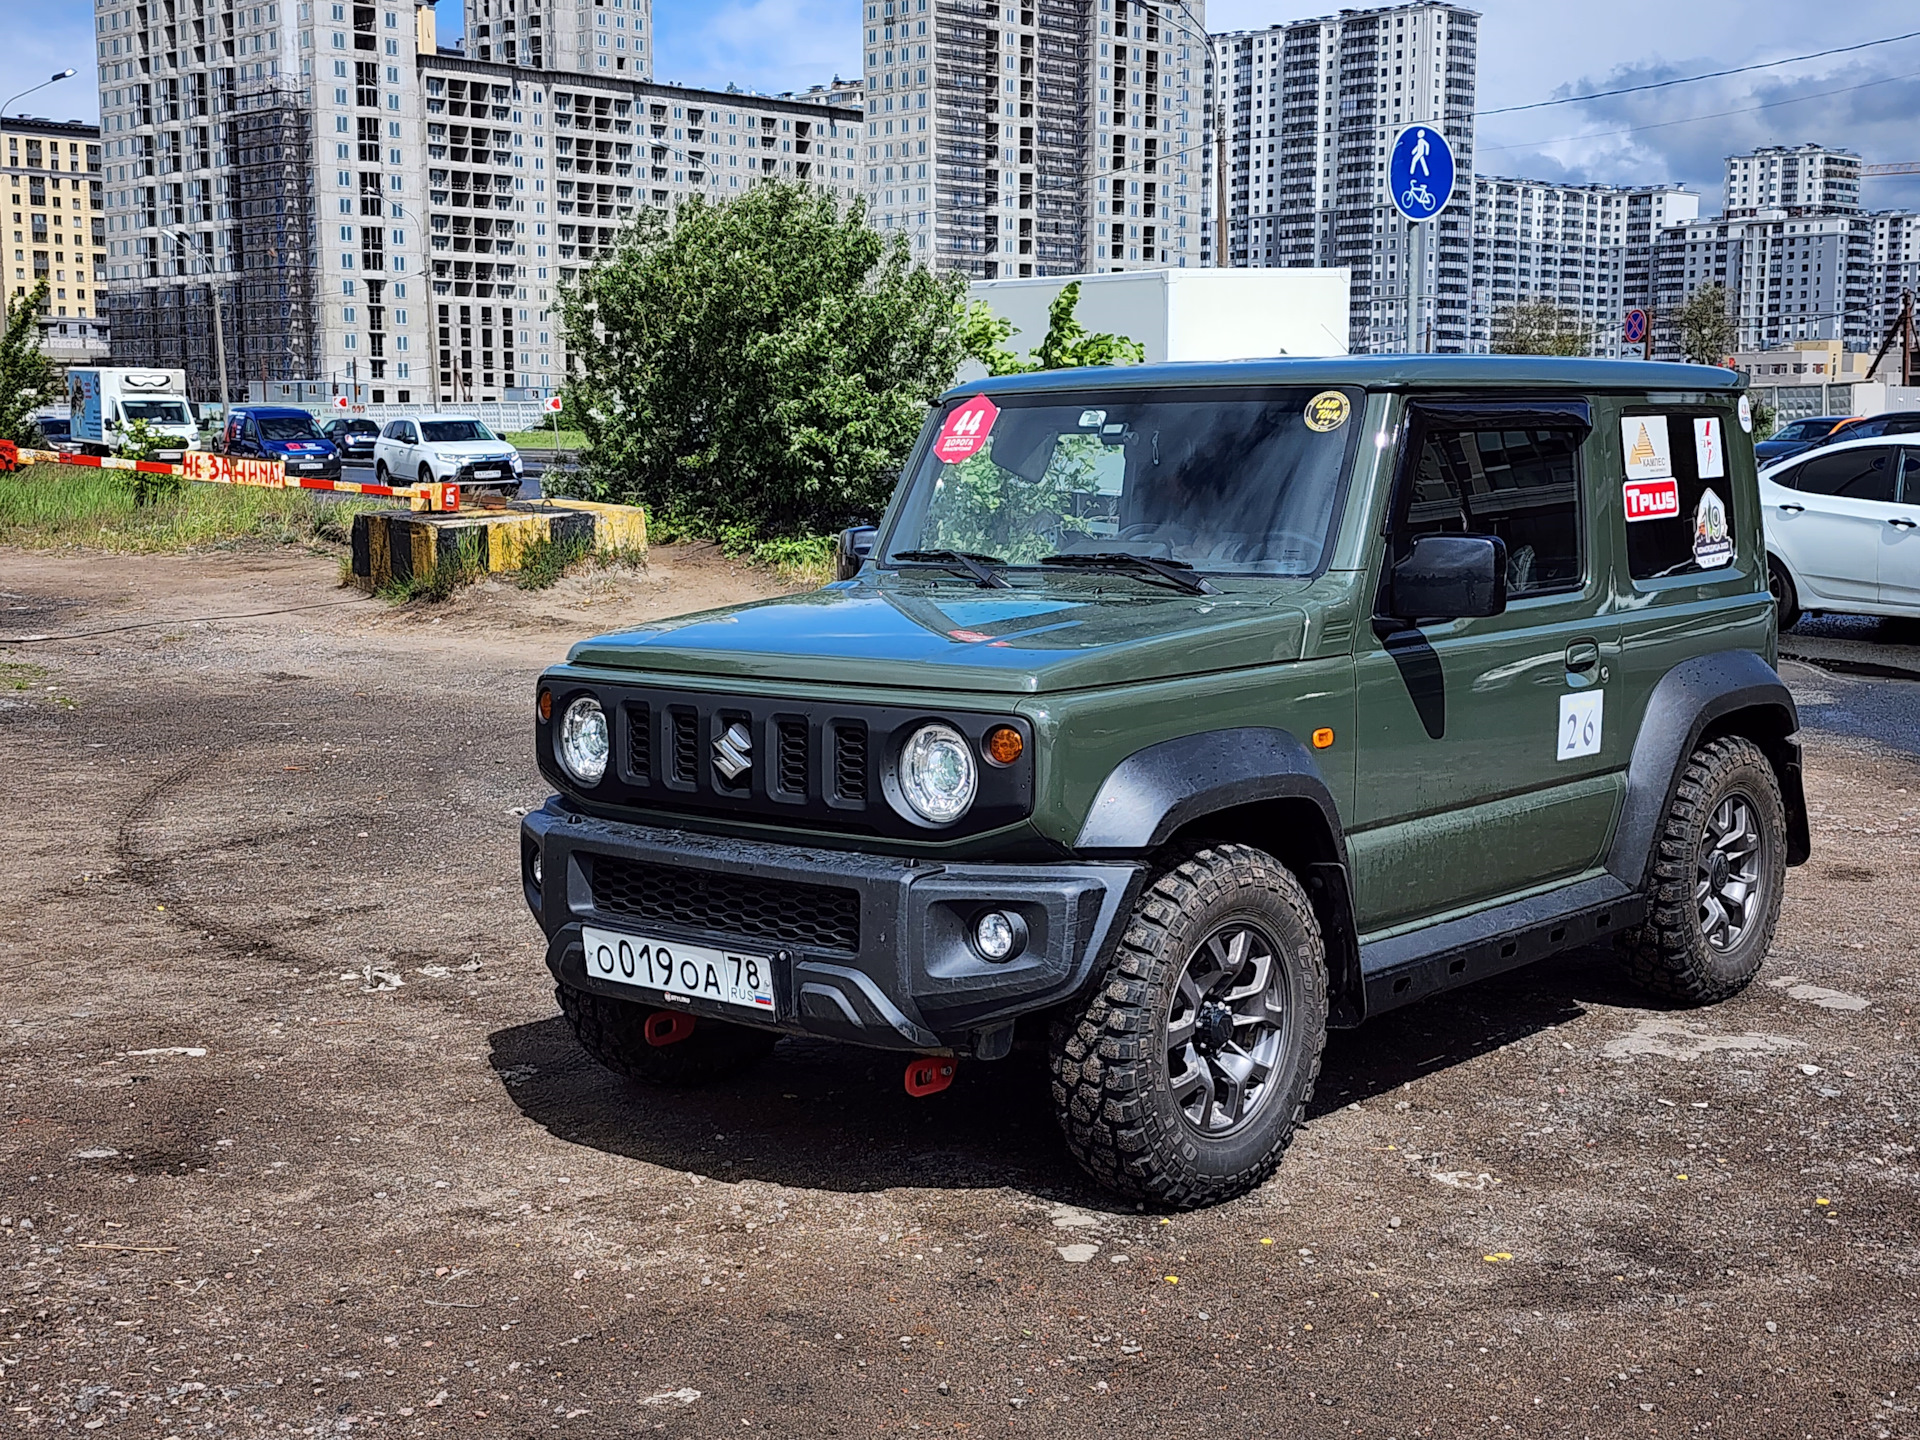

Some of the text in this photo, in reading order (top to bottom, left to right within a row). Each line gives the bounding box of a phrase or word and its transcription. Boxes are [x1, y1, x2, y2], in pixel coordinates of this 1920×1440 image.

[1315, 399, 1341, 410] LAND
[1315, 409, 1341, 421] TOUR
[952, 409, 985, 436] 44
[183, 450, 202, 478] НЕ
[1626, 488, 1676, 514] TPLUS
[1566, 709, 1594, 751] 26
[727, 955, 761, 990] 78
[730, 987, 755, 1002] RUS
